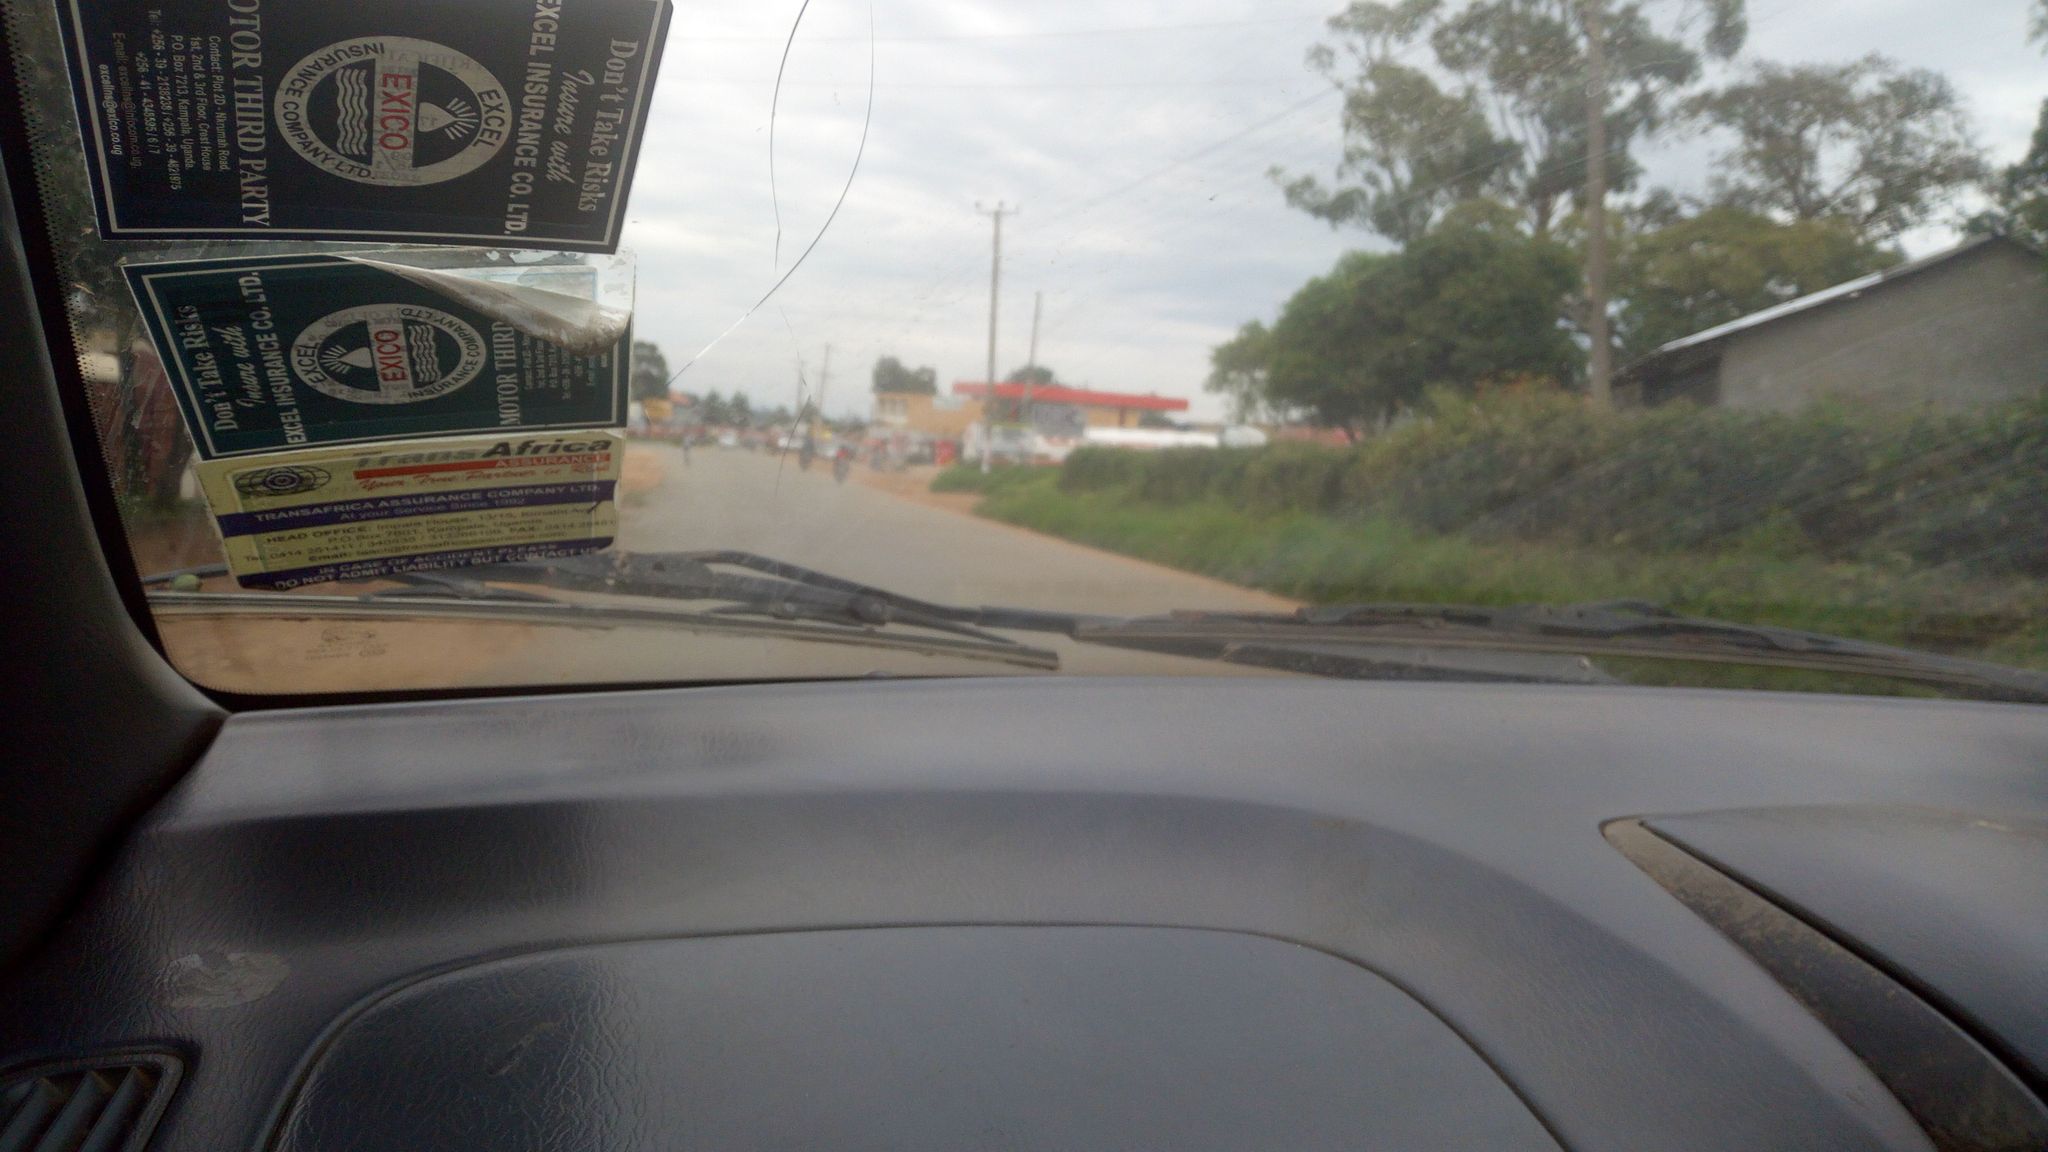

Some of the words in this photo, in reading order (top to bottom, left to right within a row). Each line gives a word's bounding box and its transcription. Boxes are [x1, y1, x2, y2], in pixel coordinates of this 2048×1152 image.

[208, 35, 222, 72] Contact:
[227, 0, 262, 69] OTOR
[173, 54, 186, 73] Box
[192, 54, 205, 71] 2nd
[211, 72, 224, 92] Plot
[284, 42, 385, 98] INSURANCE
[601, 37, 639, 103] Don't
[194, 82, 207, 96] 3rd
[553, 69, 595, 134] Insure
[215, 112, 230, 149] Nkrumah
[234, 75, 267, 152] THIRD
[378, 72, 412, 150] EXICO
[472, 88, 506, 148] EXCEL
[513, 62, 551, 167] INSURANCE
[199, 121, 211, 145] Crest
[282, 101, 336, 164] COMPANY
[588, 108, 624, 156] Take
[201, 146, 213, 171] House
[334, 159, 376, 180] LTD.
[546, 140, 576, 184] with
[238, 156, 271, 227] PARTY
[509, 172, 535, 198] CO.
[578, 160, 613, 212] Risks
[503, 203, 530, 234] LTD.
[238, 271, 267, 303] LTD.
[175, 304, 210, 349] Risks
[248, 306, 274, 330] CO.
[434, 316, 481, 359] COMPANY
[211, 325, 250, 358] with
[374, 329, 409, 382] EXICO
[192, 351, 223, 389] Take
[255, 332, 297, 406] INSURANCE
[297, 342, 327, 384] EXCEL
[408, 358, 478, 399] INSURANCE
[235, 362, 266, 407] Insure
[496, 372, 521, 425] MOTOR
[205, 390, 239, 431] Don't
[279, 407, 308, 444] EXCEL
[495, 453, 611, 468] ASSURANCE
[255, 500, 375, 523] TRANSAFRICA
[378, 491, 482, 509] ASSURANCE
[487, 485, 567, 498] COMPANY
[356, 509, 390, 521] your
[266, 533, 308, 545] HEAD
[413, 550, 494, 565] ACCIDENT
[274, 578, 299, 592] DO
[302, 573, 336, 586] NOT
[340, 566, 389, 581] ADMIT
[393, 559, 467, 575] LIABILITY
[471, 552, 503, 565] BUT
